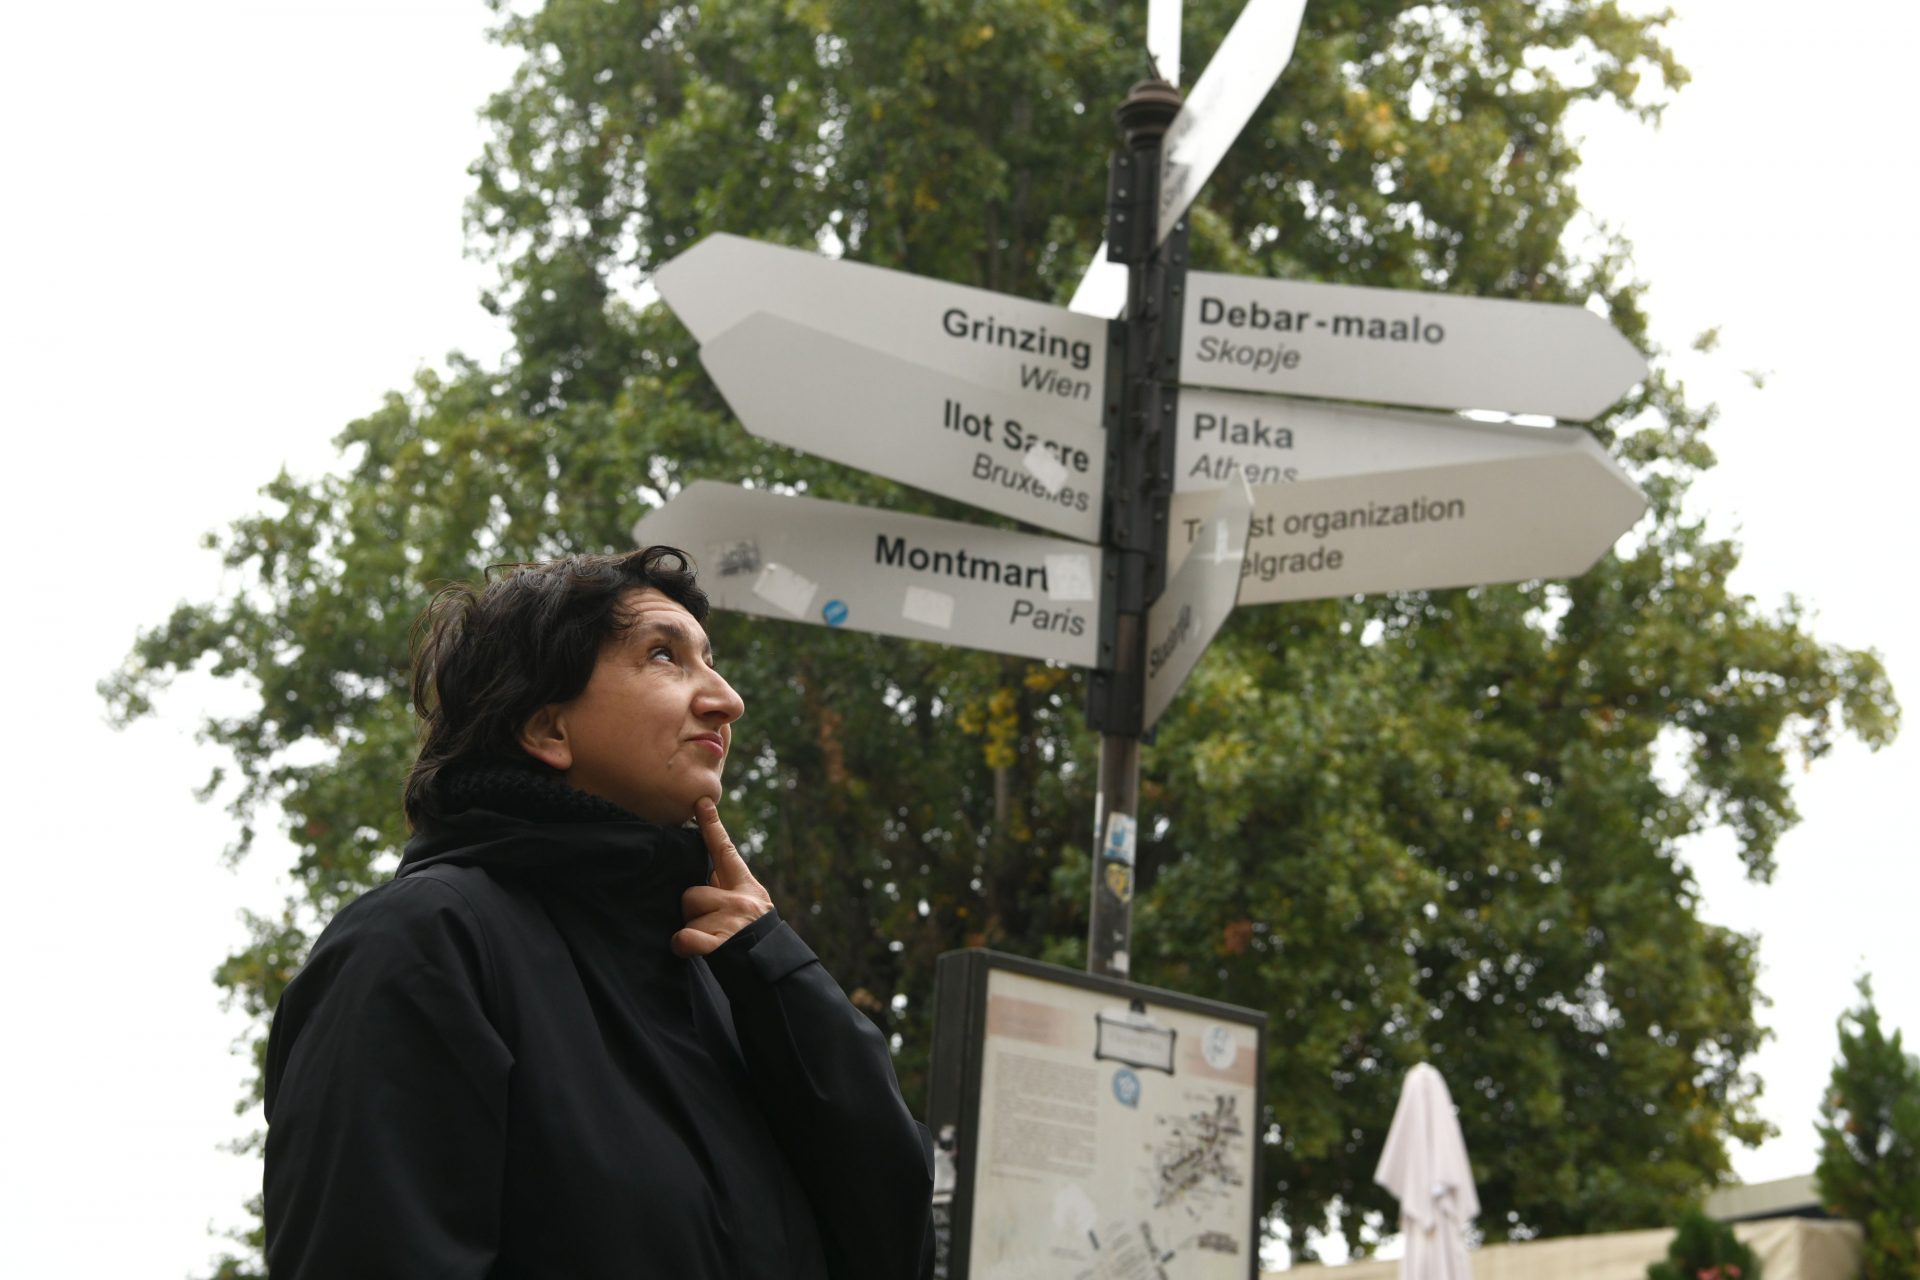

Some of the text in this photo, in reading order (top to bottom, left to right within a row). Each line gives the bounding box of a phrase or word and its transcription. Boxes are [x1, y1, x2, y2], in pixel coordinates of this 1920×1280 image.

[942, 308, 1092, 371] Grinzing
[1199, 296, 1446, 345] Debar-maalo
[1196, 335, 1302, 375] Skopje
[1020, 362, 1092, 401] Wien
[943, 398, 994, 443] Ilot
[1193, 413, 1295, 450] Plaka
[971, 451, 1090, 513] Bruxees
[1283, 497, 1466, 539] organization
[875, 533, 1049, 593] Montmart
[1240, 546, 1344, 582] elgrade
[1009, 598, 1087, 637] Paris
